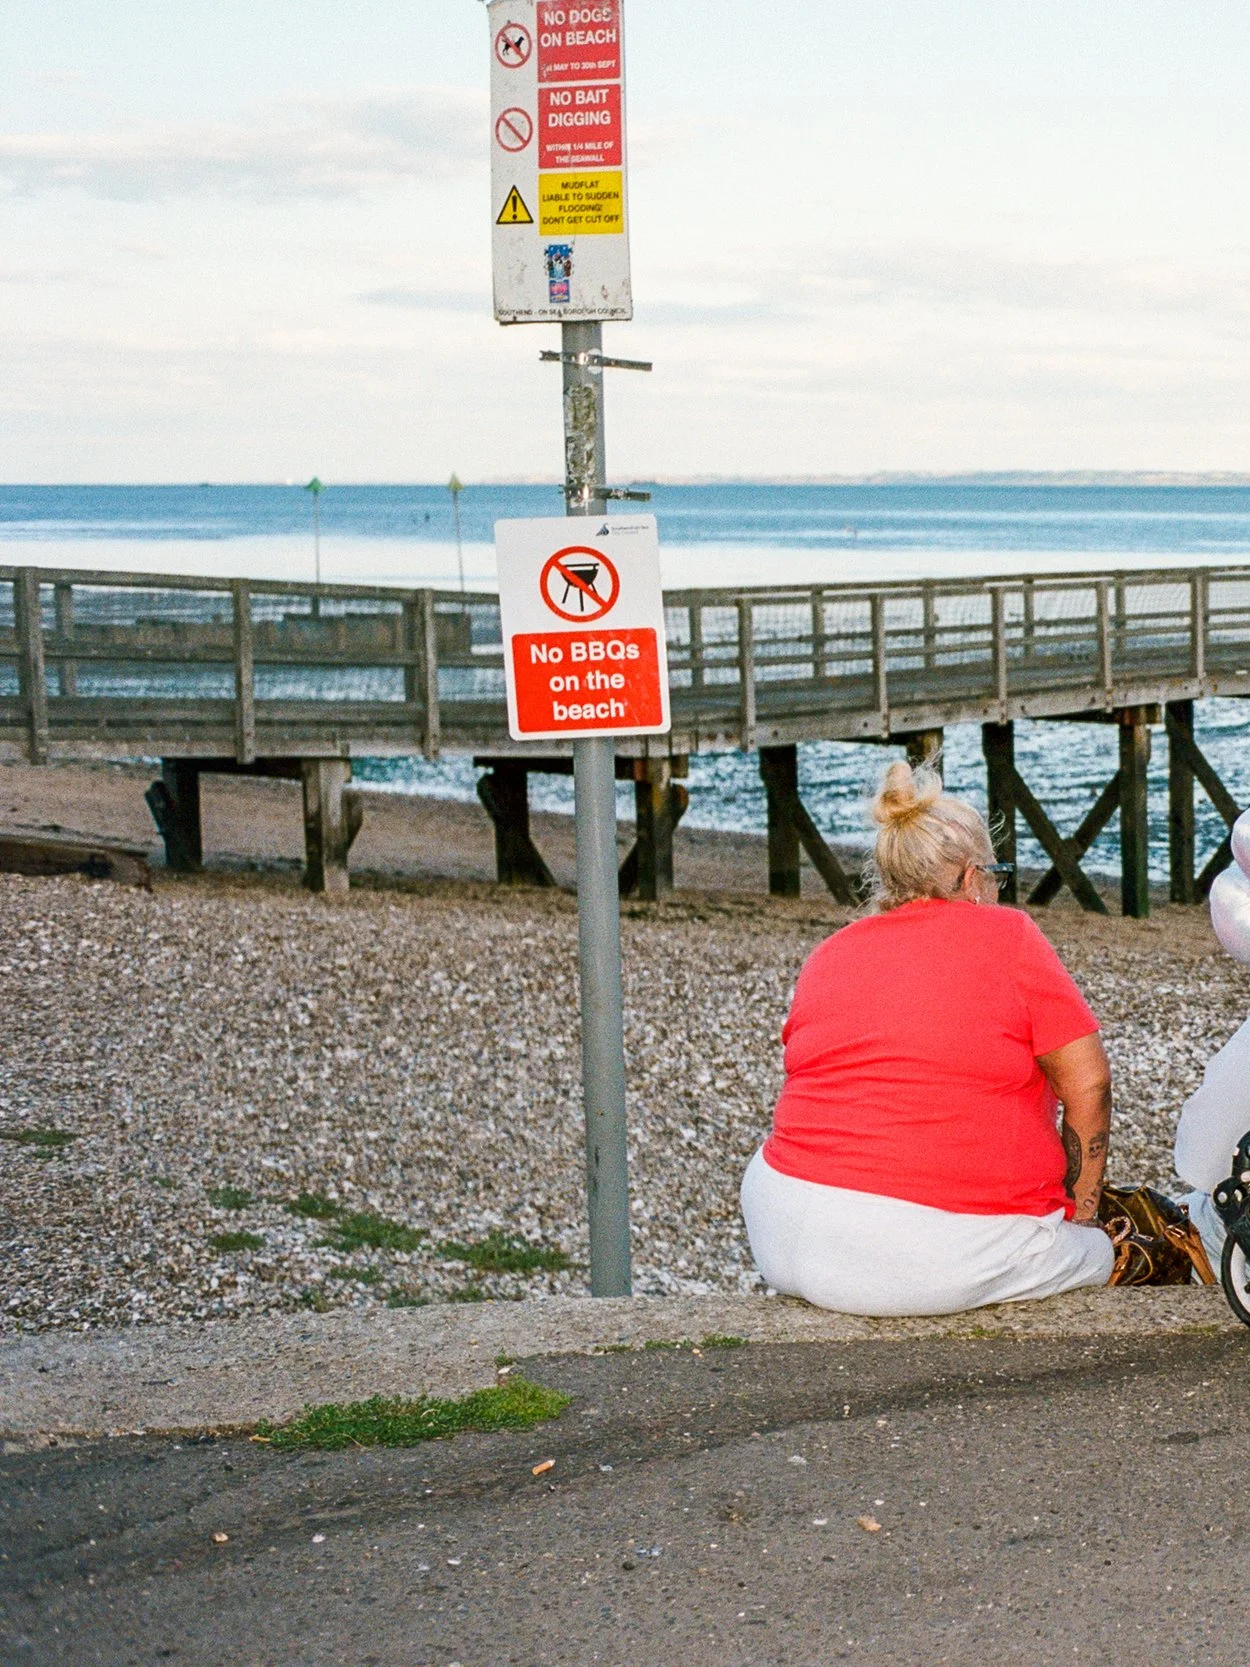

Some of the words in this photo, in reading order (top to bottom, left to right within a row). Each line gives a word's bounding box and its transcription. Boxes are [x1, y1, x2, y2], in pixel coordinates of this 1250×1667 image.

[544, 11, 566, 26] NO
[569, 8, 612, 24] DOGS
[540, 32, 562, 47] ON
[565, 29, 617, 46] BEACH
[570, 61, 581, 70] TO
[550, 91, 572, 106] NO
[575, 89, 609, 105] BAIT
[548, 110, 611, 127] DIGGING
[603, 141, 614, 150] OF
[561, 181, 599, 190] MUDFLAT
[542, 193, 570, 202] LIABLE
[572, 192, 584, 201] TO
[585, 191, 620, 201] SUDDEN
[567, 215, 583, 224] GET
[585, 215, 602, 224] CUT
[603, 214, 620, 223] OFF
[530, 643, 563, 664] No
[571, 639, 641, 663] BBQs
[549, 674, 580, 692] on
[586, 670, 625, 691] the
[552, 698, 625, 721] beach
